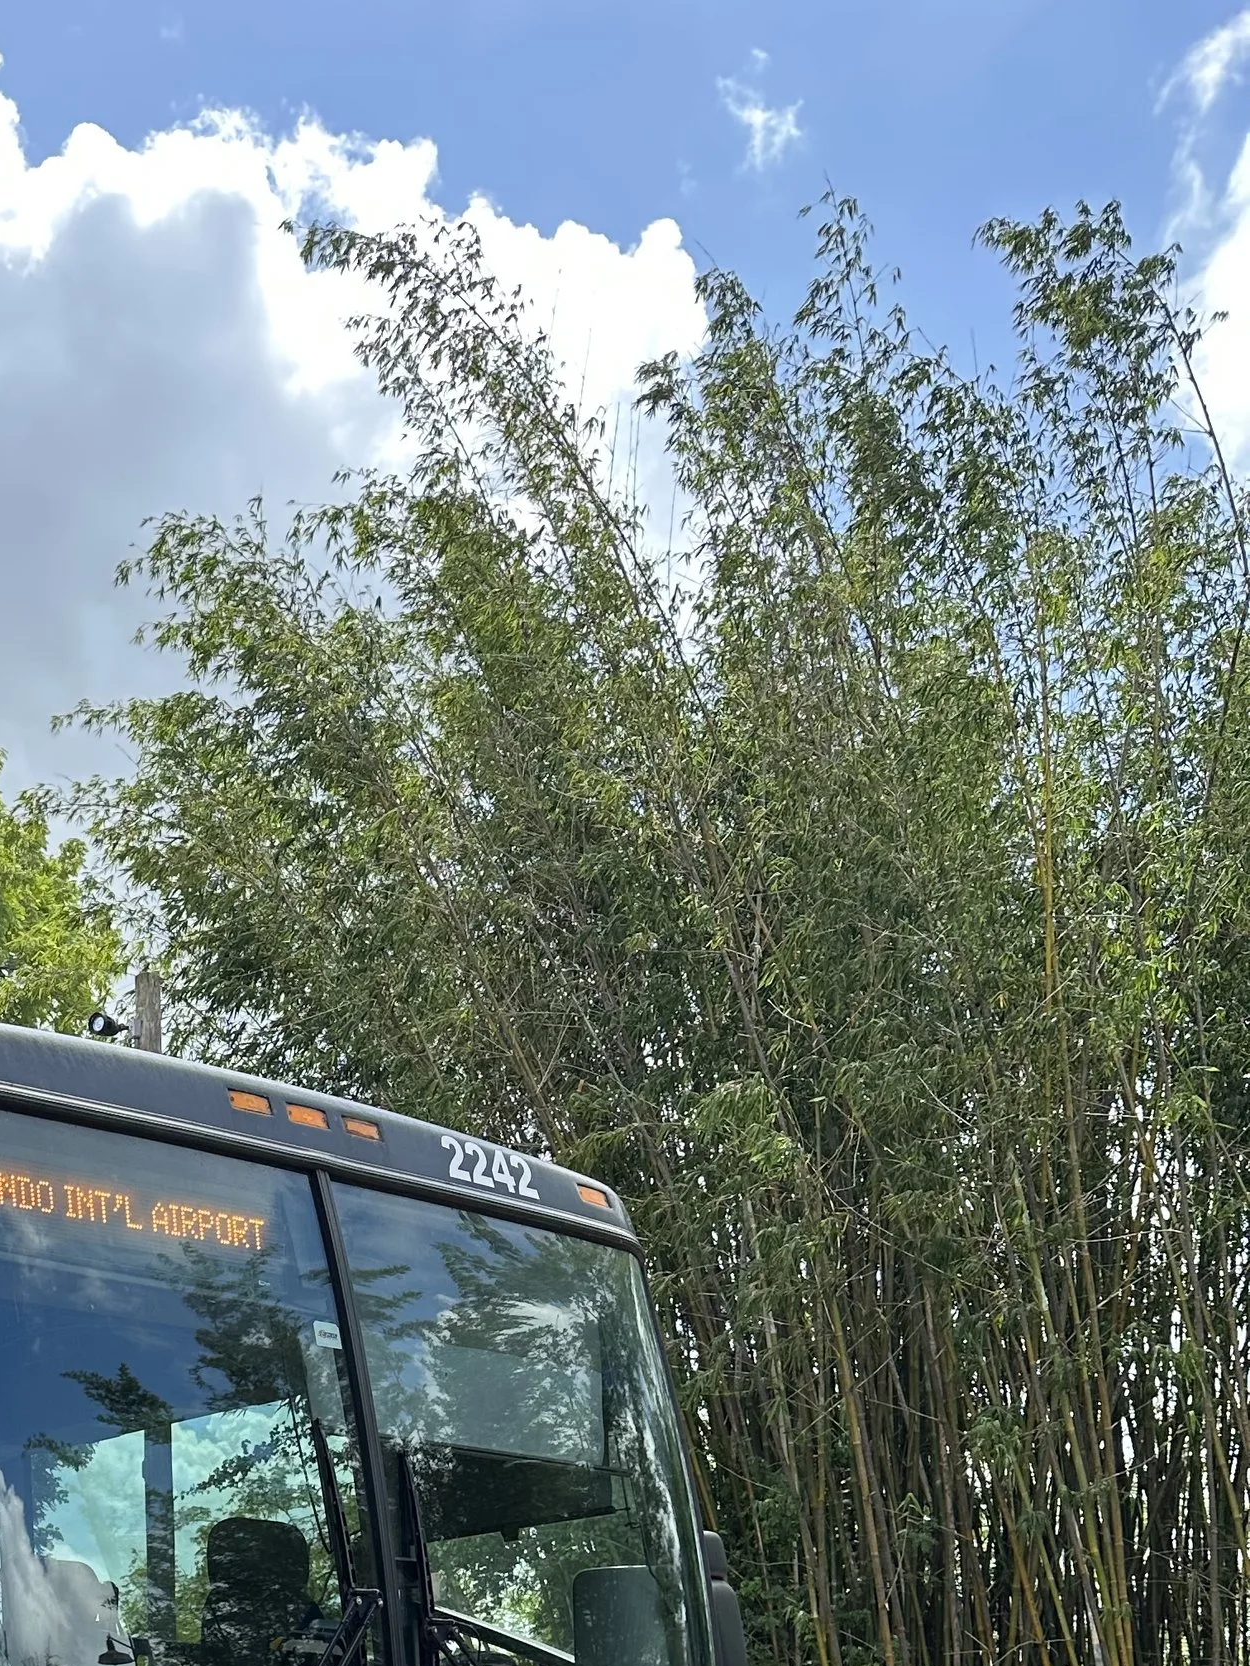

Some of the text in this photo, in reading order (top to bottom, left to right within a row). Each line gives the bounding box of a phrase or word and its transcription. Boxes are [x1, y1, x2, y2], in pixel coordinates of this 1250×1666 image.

[441, 1135, 540, 1200] 2242
[62, 1183, 144, 1231] INT'L
[151, 1201, 266, 1251] AIRPORT
